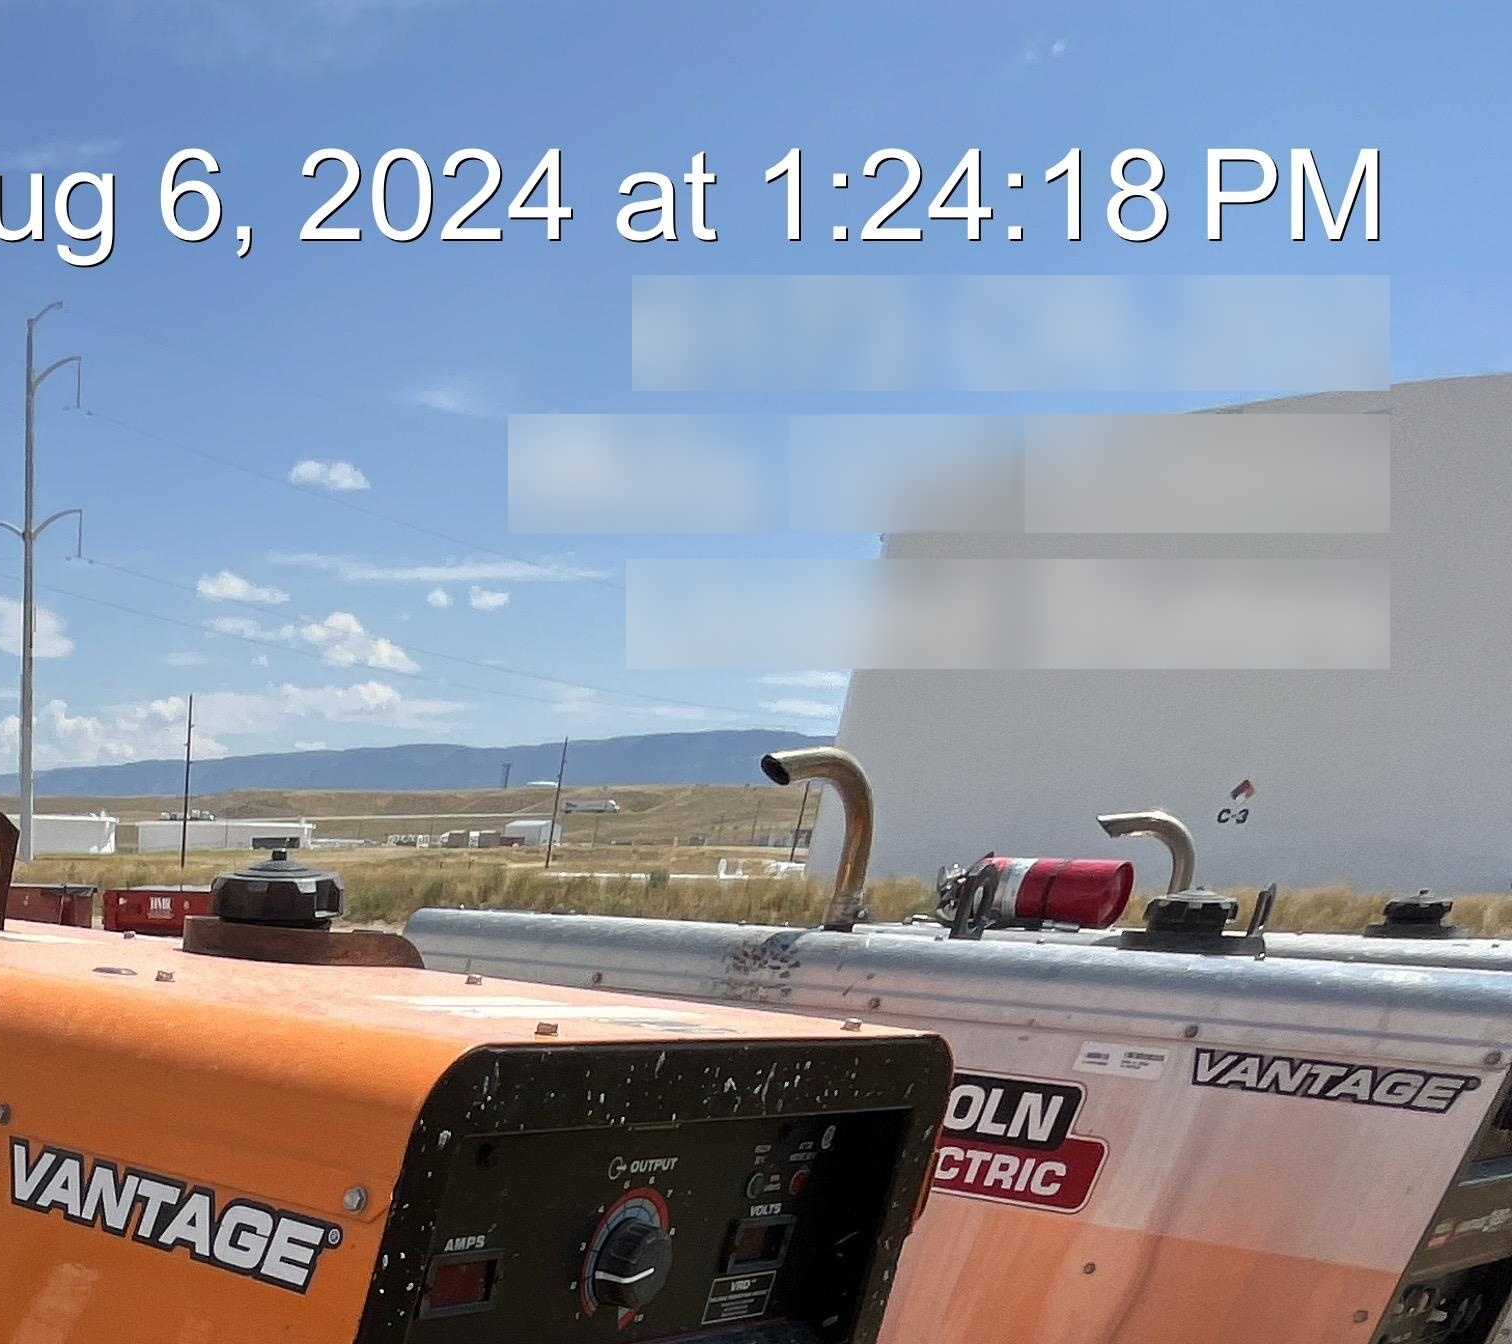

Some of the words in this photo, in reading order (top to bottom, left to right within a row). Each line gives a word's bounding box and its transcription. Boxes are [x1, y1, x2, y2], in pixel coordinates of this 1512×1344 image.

[1216, 808, 1249, 825] C-3
[1196, 1052, 1466, 1111] VANTAGE
[629, 1157, 678, 1174] OUTPUT
[934, 1146, 1067, 1196] CTRIC
[11, 1141, 326, 1288] VANTAGE
[750, 1202, 782, 1217] VOLTS
[443, 1235, 486, 1252] AMPS
